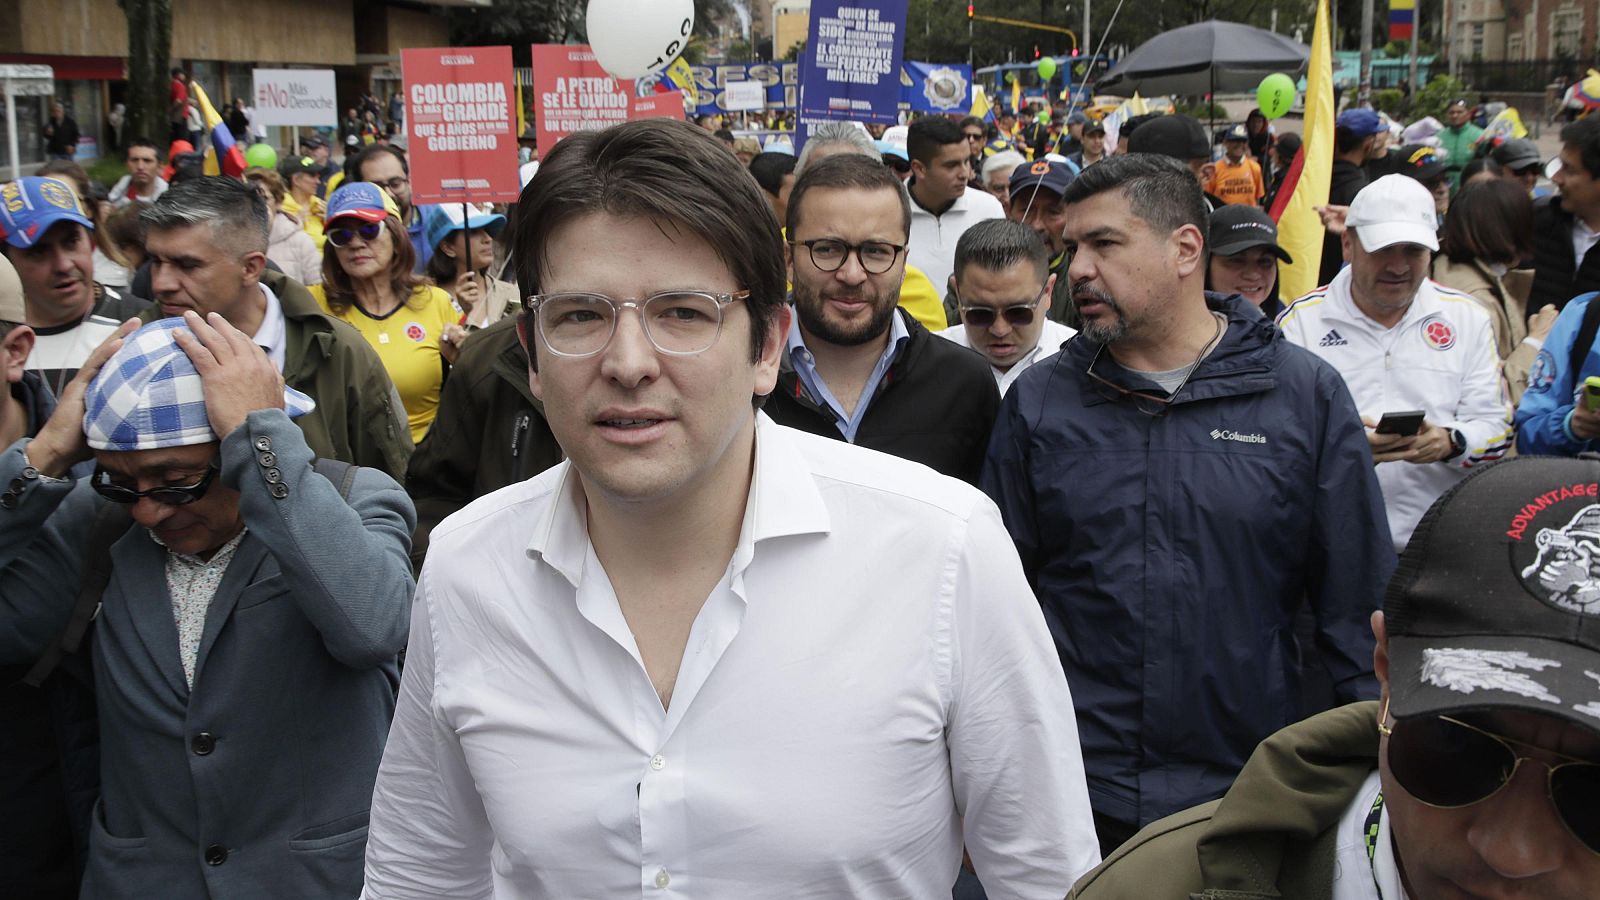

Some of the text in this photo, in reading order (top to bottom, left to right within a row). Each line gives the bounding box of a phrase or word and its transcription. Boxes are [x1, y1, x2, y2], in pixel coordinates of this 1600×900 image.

[837, 6, 880, 21] QUIEN SE
[819, 25, 846, 38] SIDO
[855, 20, 866, 31] DE
[867, 21, 896, 34] HABER
[817, 42, 893, 60] EL COMANDANTE
[837, 56, 892, 74] FUERZAS
[556, 77, 613, 93] A PETRO
[826, 69, 879, 85] MILITARES
[411, 82, 507, 104] COLOMBIA
[542, 92, 560, 108] SE
[562, 92, 577, 108] LE
[580, 89, 628, 108] OLVIDÓ
[413, 104, 423, 114] ES
[442, 102, 509, 121] GRANDE
[599, 109, 628, 119] PIERDE
[414, 123, 437, 137] QUE
[437, 123, 445, 135] 4
[447, 122, 476, 136] AÑOS
[545, 120, 627, 132] UN COLOMBIA
[428, 135, 498, 151] GOBIERNO
[1221, 430, 1266, 443] Columbia
[1506, 483, 1599, 540] ADVANTAGE
